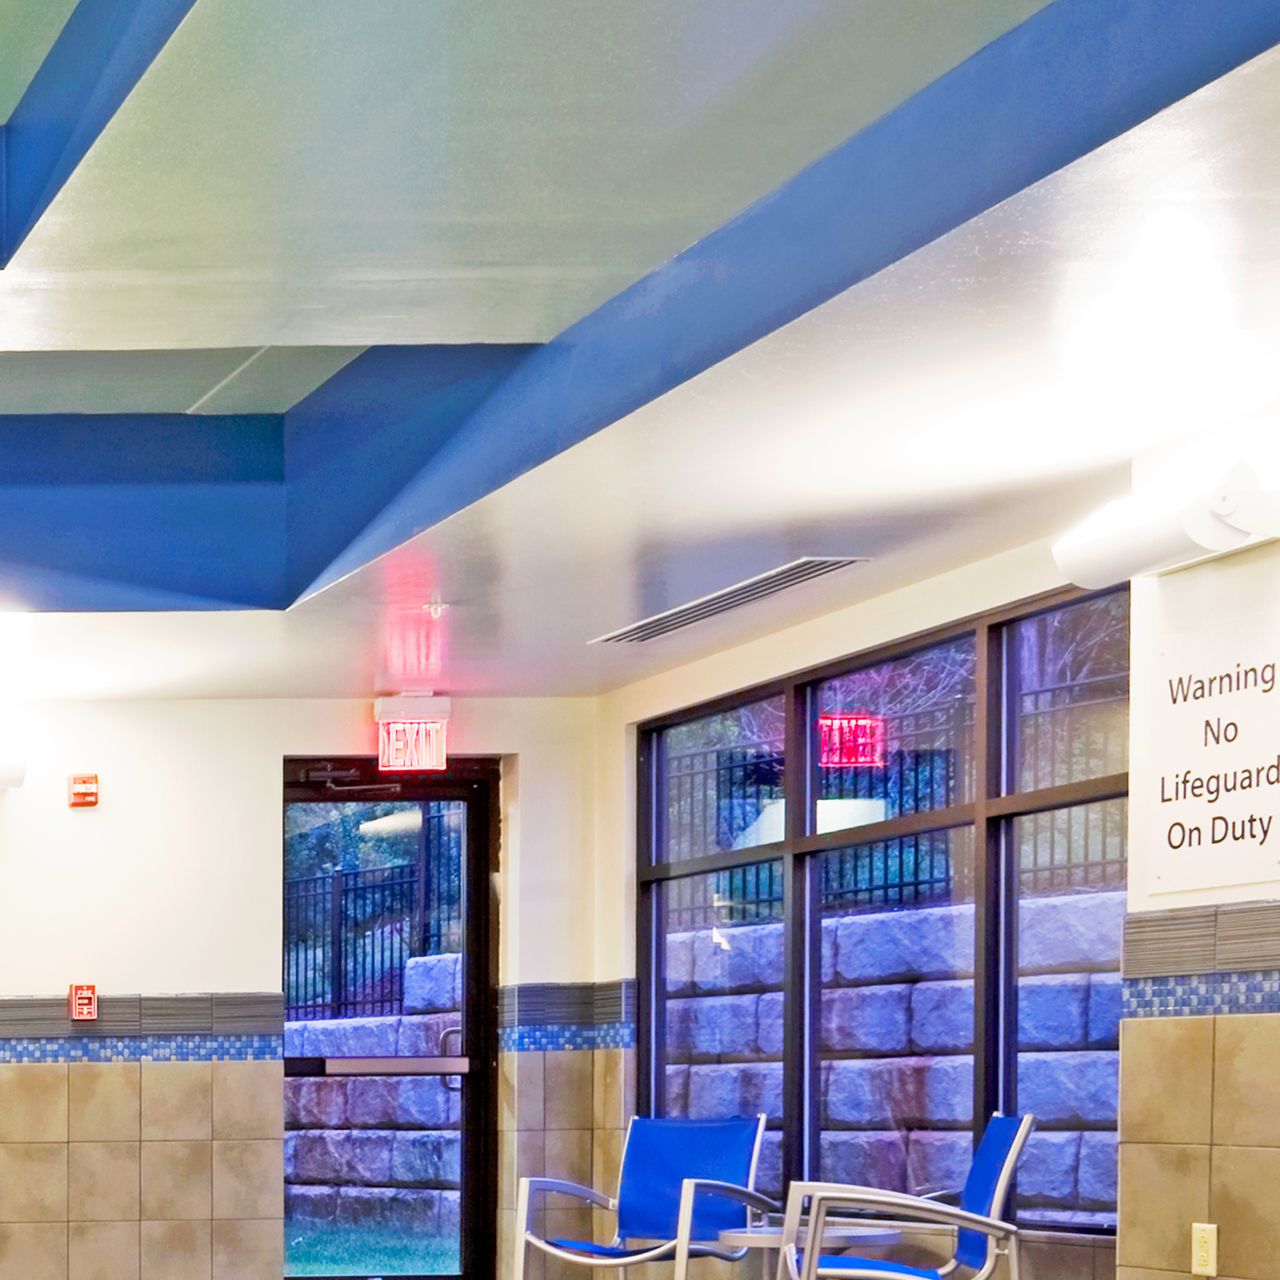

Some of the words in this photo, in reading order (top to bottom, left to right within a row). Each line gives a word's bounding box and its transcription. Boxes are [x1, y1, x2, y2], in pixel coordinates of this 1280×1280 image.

[1168, 662, 1276, 704] Warning
[389, 723, 441, 767] EXIT
[1203, 717, 1239, 747] No
[1160, 754, 1280, 804] Lifeguard
[1167, 821, 1202, 850] On
[1211, 813, 1273, 846] Duty
